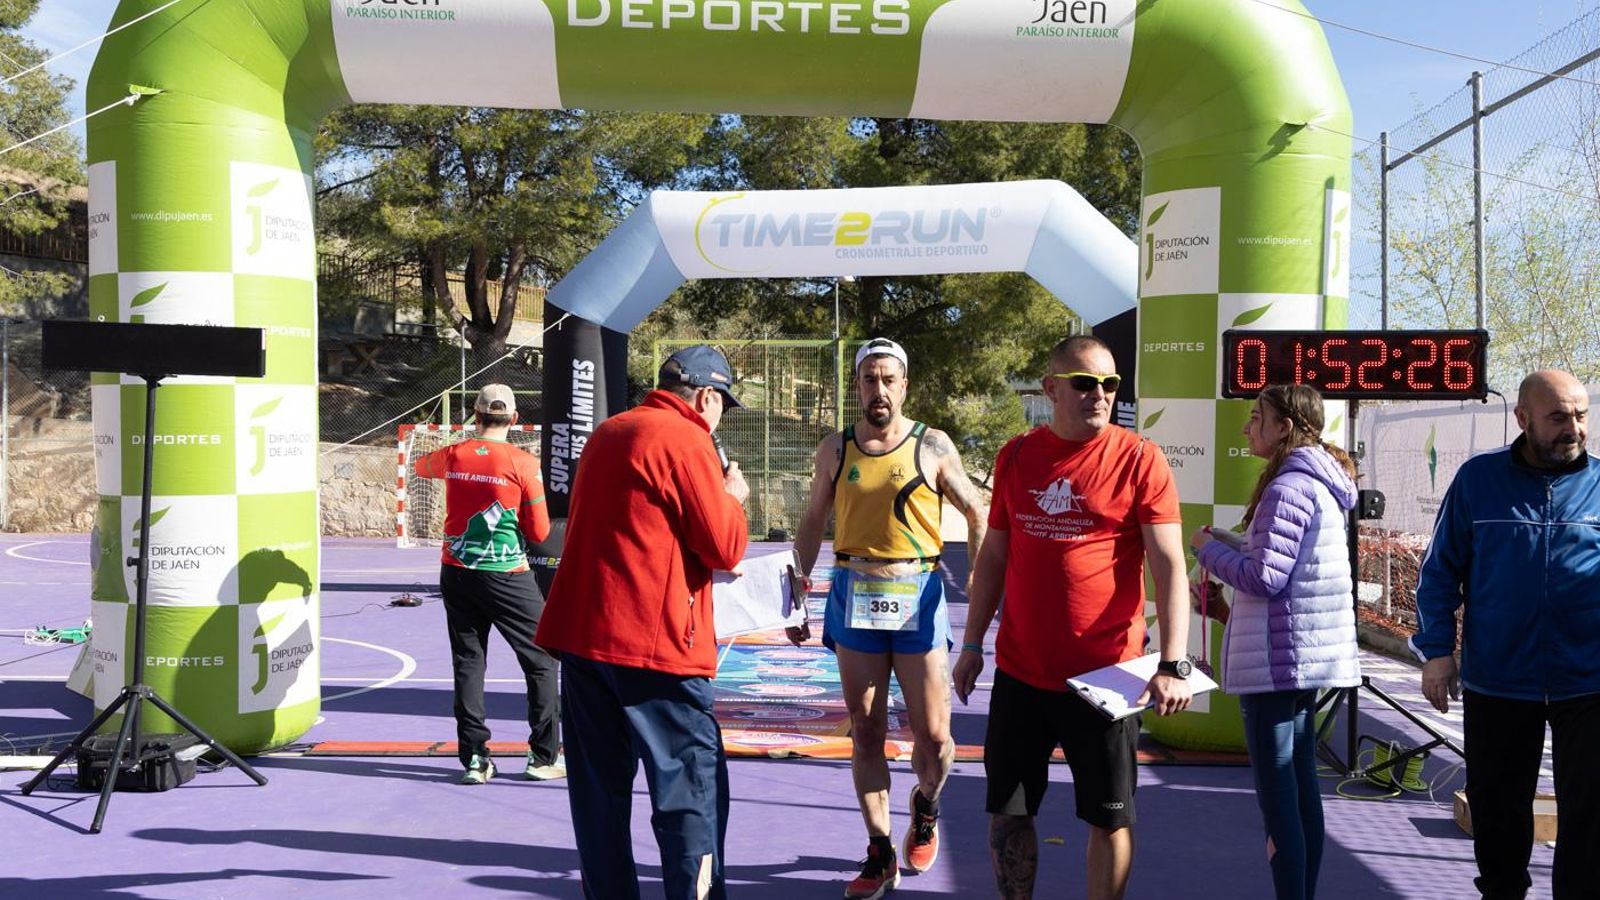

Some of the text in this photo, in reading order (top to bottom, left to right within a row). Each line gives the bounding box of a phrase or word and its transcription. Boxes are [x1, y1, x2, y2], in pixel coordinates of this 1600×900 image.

[346, 6, 456, 20] PARAÍSO INTERIOR
[568, 0, 910, 35] DEPORTES
[1016, 24, 1120, 38] PARAÍSO INTERIOR
[130, 209, 214, 223] www.dipujaen.es
[1155, 236, 1210, 249] DIPUTACIÓN
[1237, 234, 1314, 248] www.dipujaen.es
[835, 244, 989, 260] CRONOMETRAJE DEPORTIVO
[1144, 342, 1205, 352] DEPORTES
[1237, 339, 1475, 390] 01:52:26
[567, 358, 595, 432] LÍMITES
[1158, 445, 1205, 456] UTACIÓN
[550, 423, 570, 494] SUPERA
[470, 473, 509, 486] ARBITRAL
[1057, 516, 1095, 526] ANDALUZA
[152, 545, 226, 556] DIPUTACIÓN
[152, 558, 200, 571] DE JAÉN
[870, 601, 899, 613] 393
[146, 656, 224, 666] EPORTES
[271, 660, 284, 673] DE
